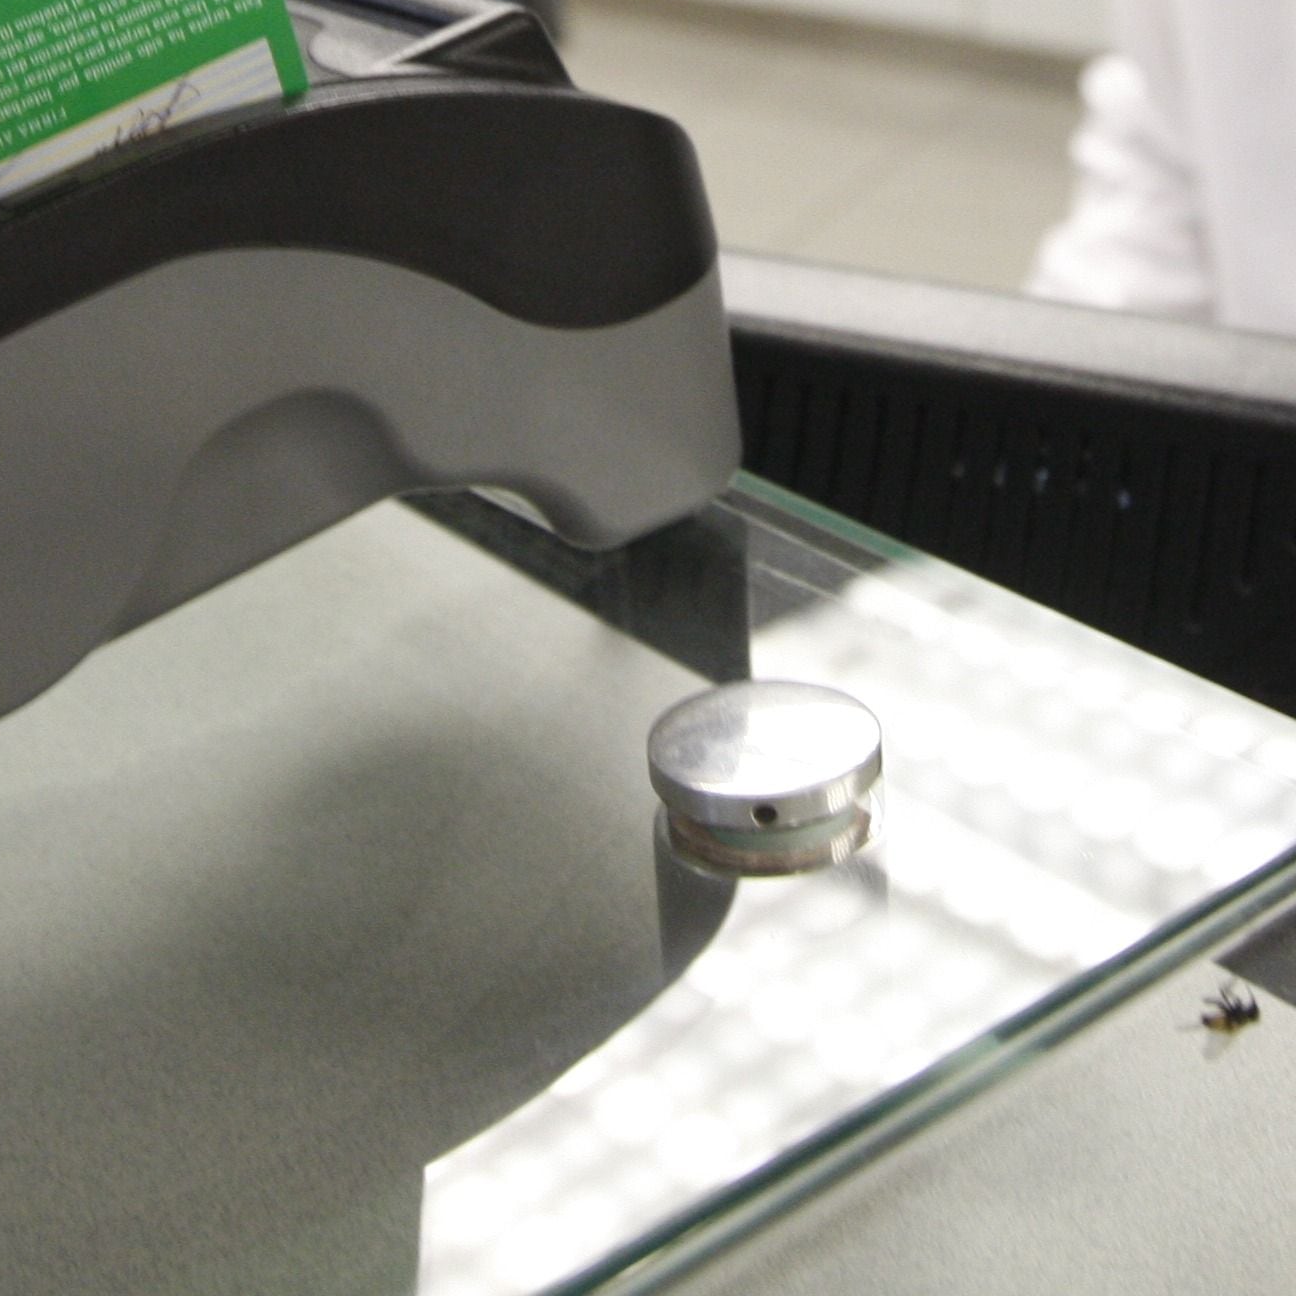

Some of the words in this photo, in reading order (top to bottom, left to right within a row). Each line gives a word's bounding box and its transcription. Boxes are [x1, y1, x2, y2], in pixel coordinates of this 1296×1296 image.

[100, 18, 115, 36] la
[152, 9, 180, 33] esta
[186, 2, 230, 37] tarjeta
[106, 20, 151, 53] tarjeta
[136, 36, 164, 60] sido
[167, 26, 185, 46] ha
[73, 40, 105, 66] para
[6, 57, 28, 78] del
[23, 57, 73, 91] realizar
[83, 50, 133, 84] emitida
[56, 70, 79, 93] por
[17, 106, 66, 139] FIRMA
